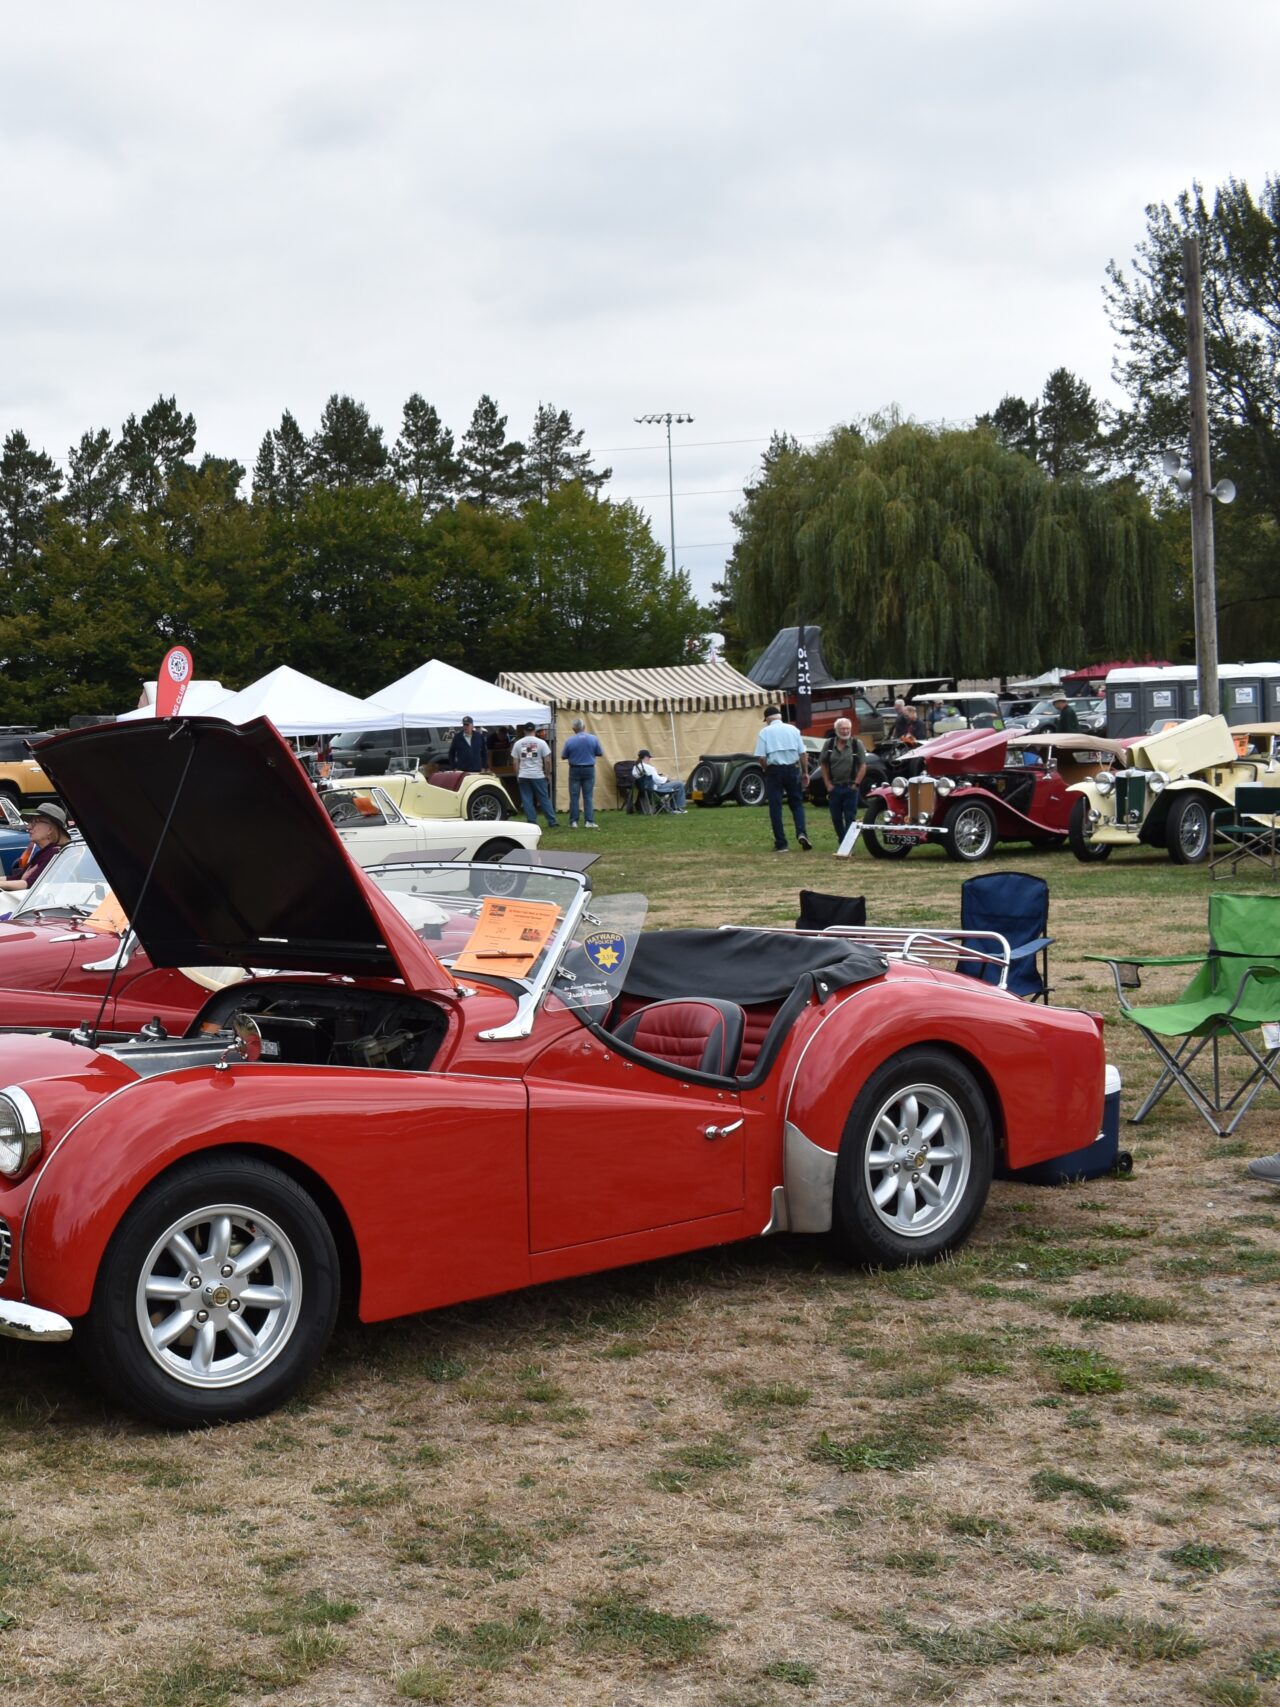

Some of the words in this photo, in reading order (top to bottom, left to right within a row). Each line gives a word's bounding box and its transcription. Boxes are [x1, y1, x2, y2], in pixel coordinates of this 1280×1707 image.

[798, 648, 806, 694] AUTO
[176, 684, 186, 704] CLUB
[586, 933, 621, 945] HAYWARD
